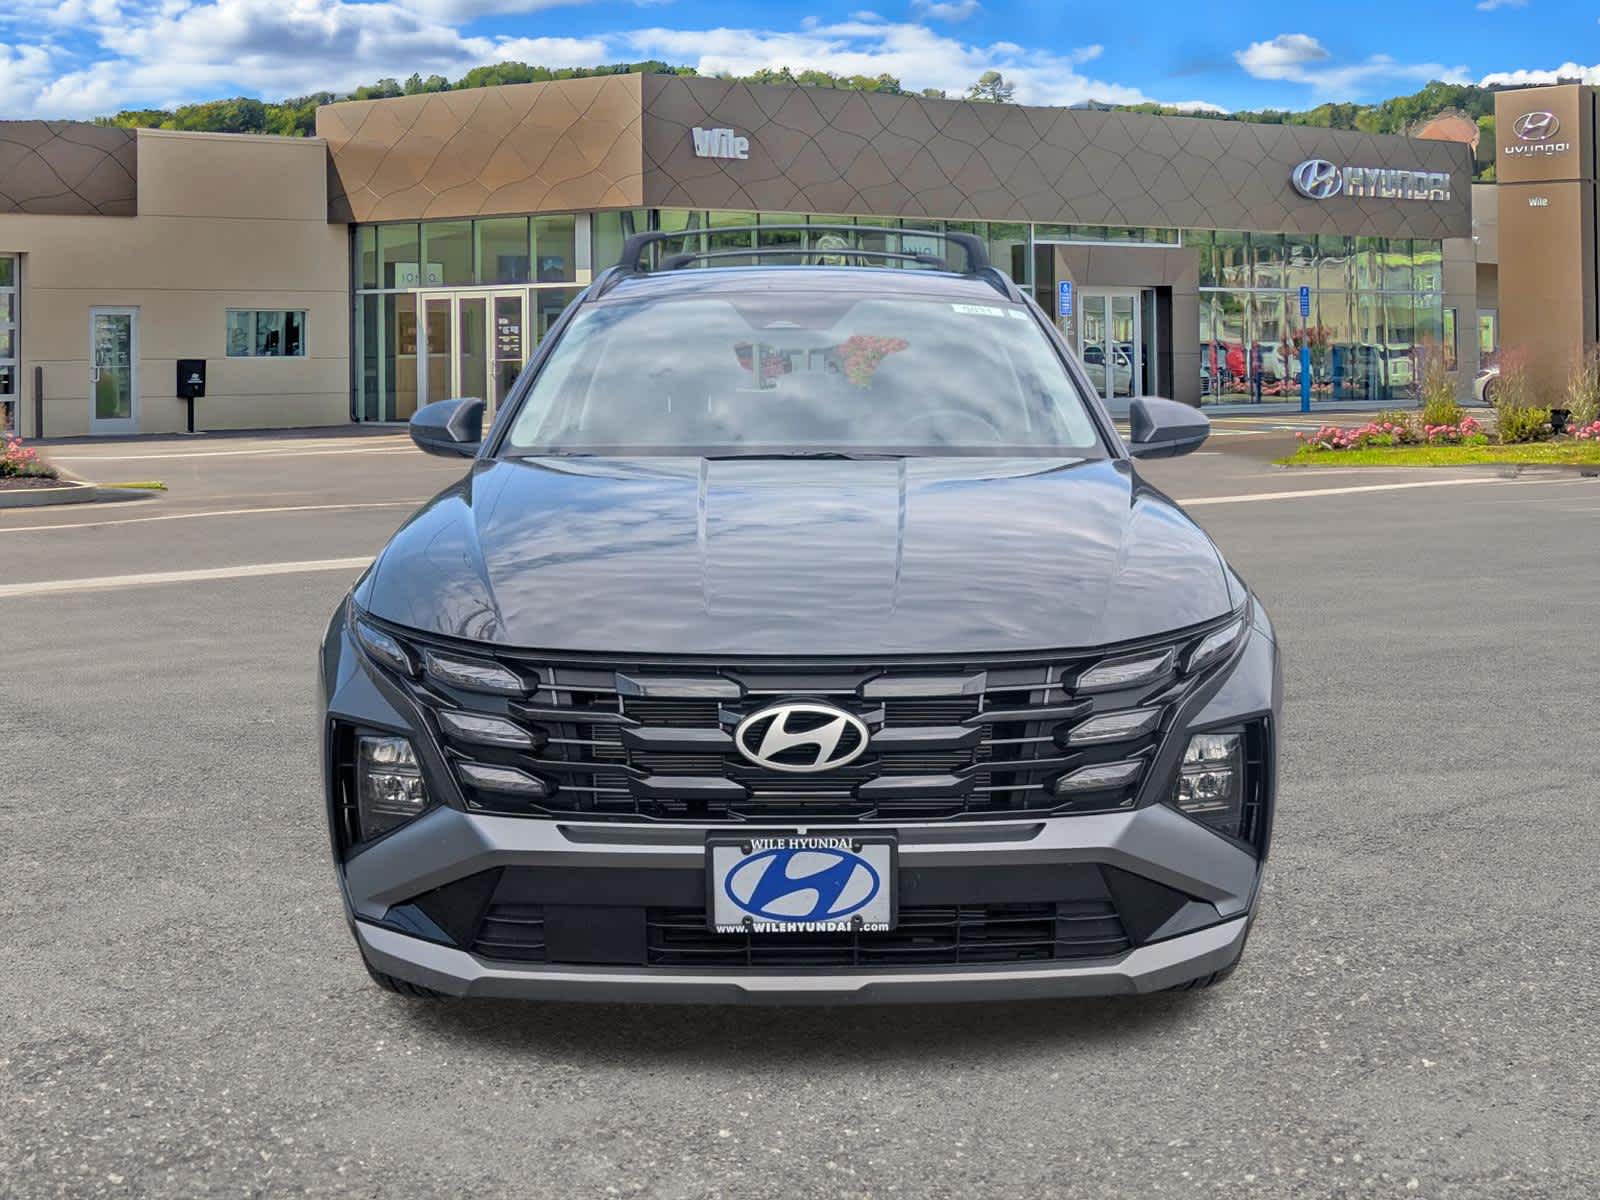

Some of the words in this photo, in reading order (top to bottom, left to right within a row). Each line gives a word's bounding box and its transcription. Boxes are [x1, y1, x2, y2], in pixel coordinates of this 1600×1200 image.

[691, 127, 749, 160] Wile
[1342, 166, 1451, 201] HYUNDAI
[1528, 197, 1549, 207] Wile
[751, 839, 785, 850] WILE
[789, 838, 853, 849] HYUNDAI
[716, 924, 749, 933] www.
[753, 921, 852, 933] WILEHYUNDAI
[859, 922, 889, 932] .com
